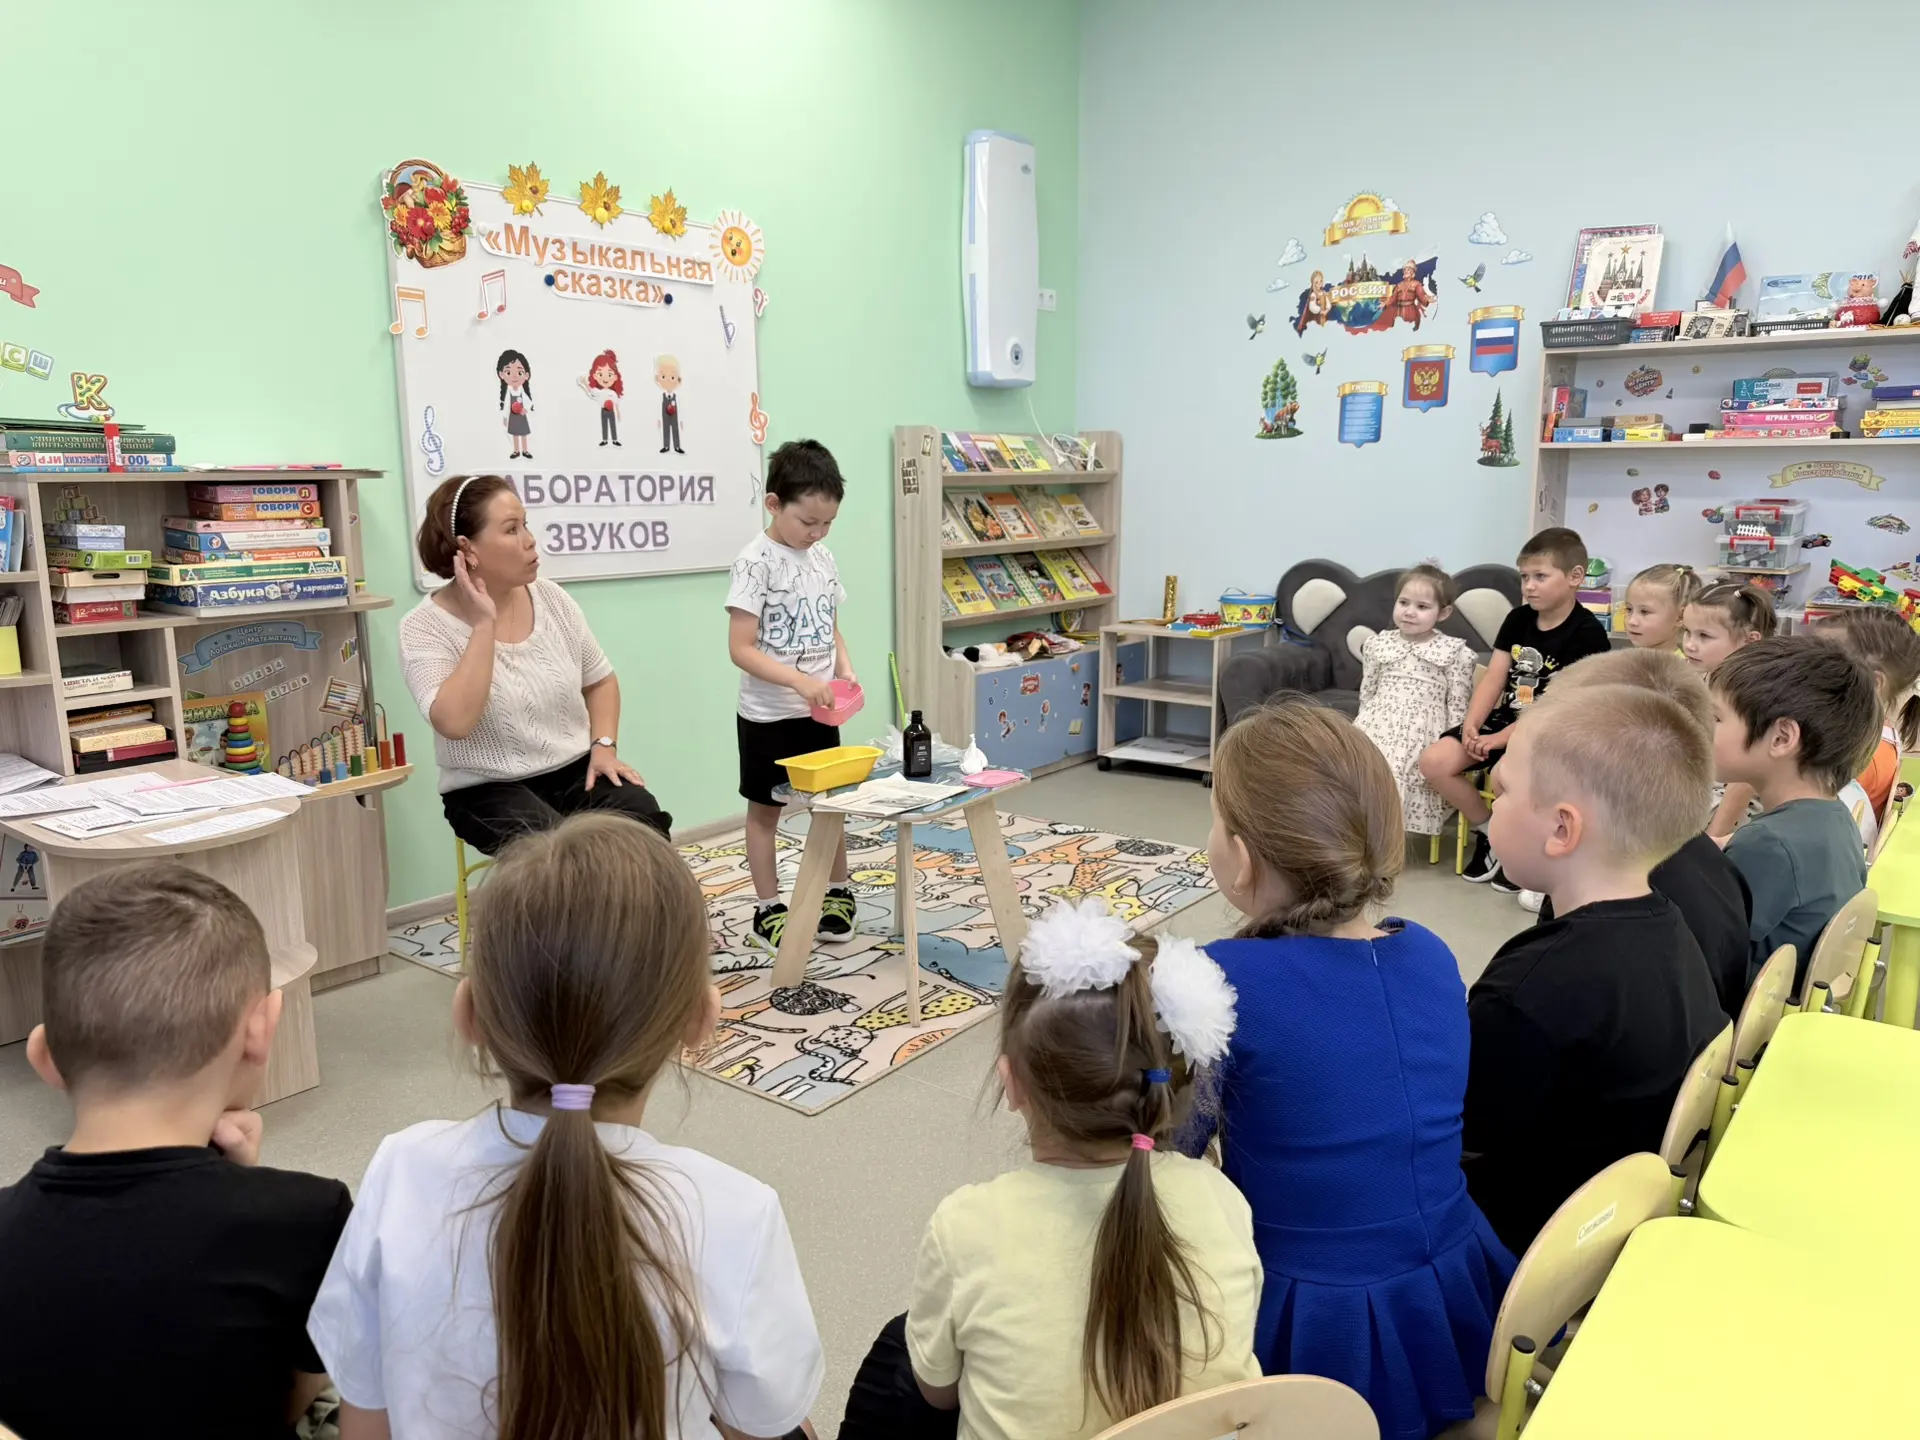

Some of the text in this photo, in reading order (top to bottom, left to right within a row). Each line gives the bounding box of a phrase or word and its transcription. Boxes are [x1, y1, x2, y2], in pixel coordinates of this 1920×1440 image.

[485, 222, 713, 282] «Музыкальная
[554, 268, 665, 305] сказка»
[1331, 284, 1388, 300] РОССИЯ
[38, 455, 62, 465] ИГР
[128, 455, 150, 465] 100
[252, 486, 297, 496] ГОВОРИ
[504, 474, 714, 504] БОРАТОРИЯ
[256, 502, 300, 512] ГОВОРИ
[545, 521, 670, 551] ЗВУКОВ
[209, 586, 265, 601] Азбука
[237, 626, 263, 636] Центр
[209, 642, 238, 657] Логики
[247, 635, 299, 643] Математики
